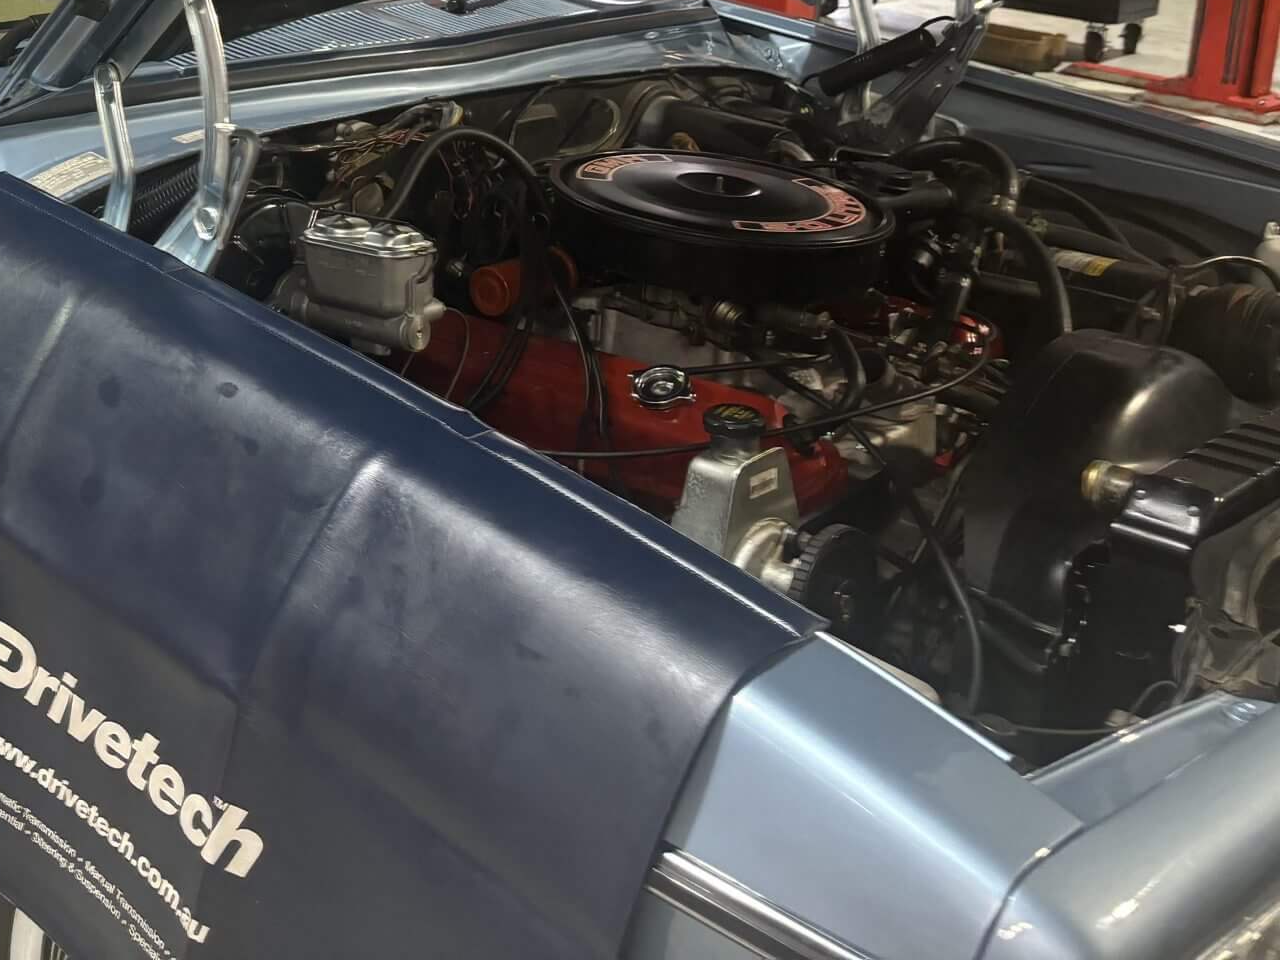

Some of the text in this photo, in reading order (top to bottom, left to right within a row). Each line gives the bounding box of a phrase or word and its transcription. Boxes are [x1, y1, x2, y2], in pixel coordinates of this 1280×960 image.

[22, 807, 77, 858] Transmission
[84, 860, 116, 894] Manual
[116, 888, 165, 949] Transmission
[74, 868, 121, 920] Suspension
